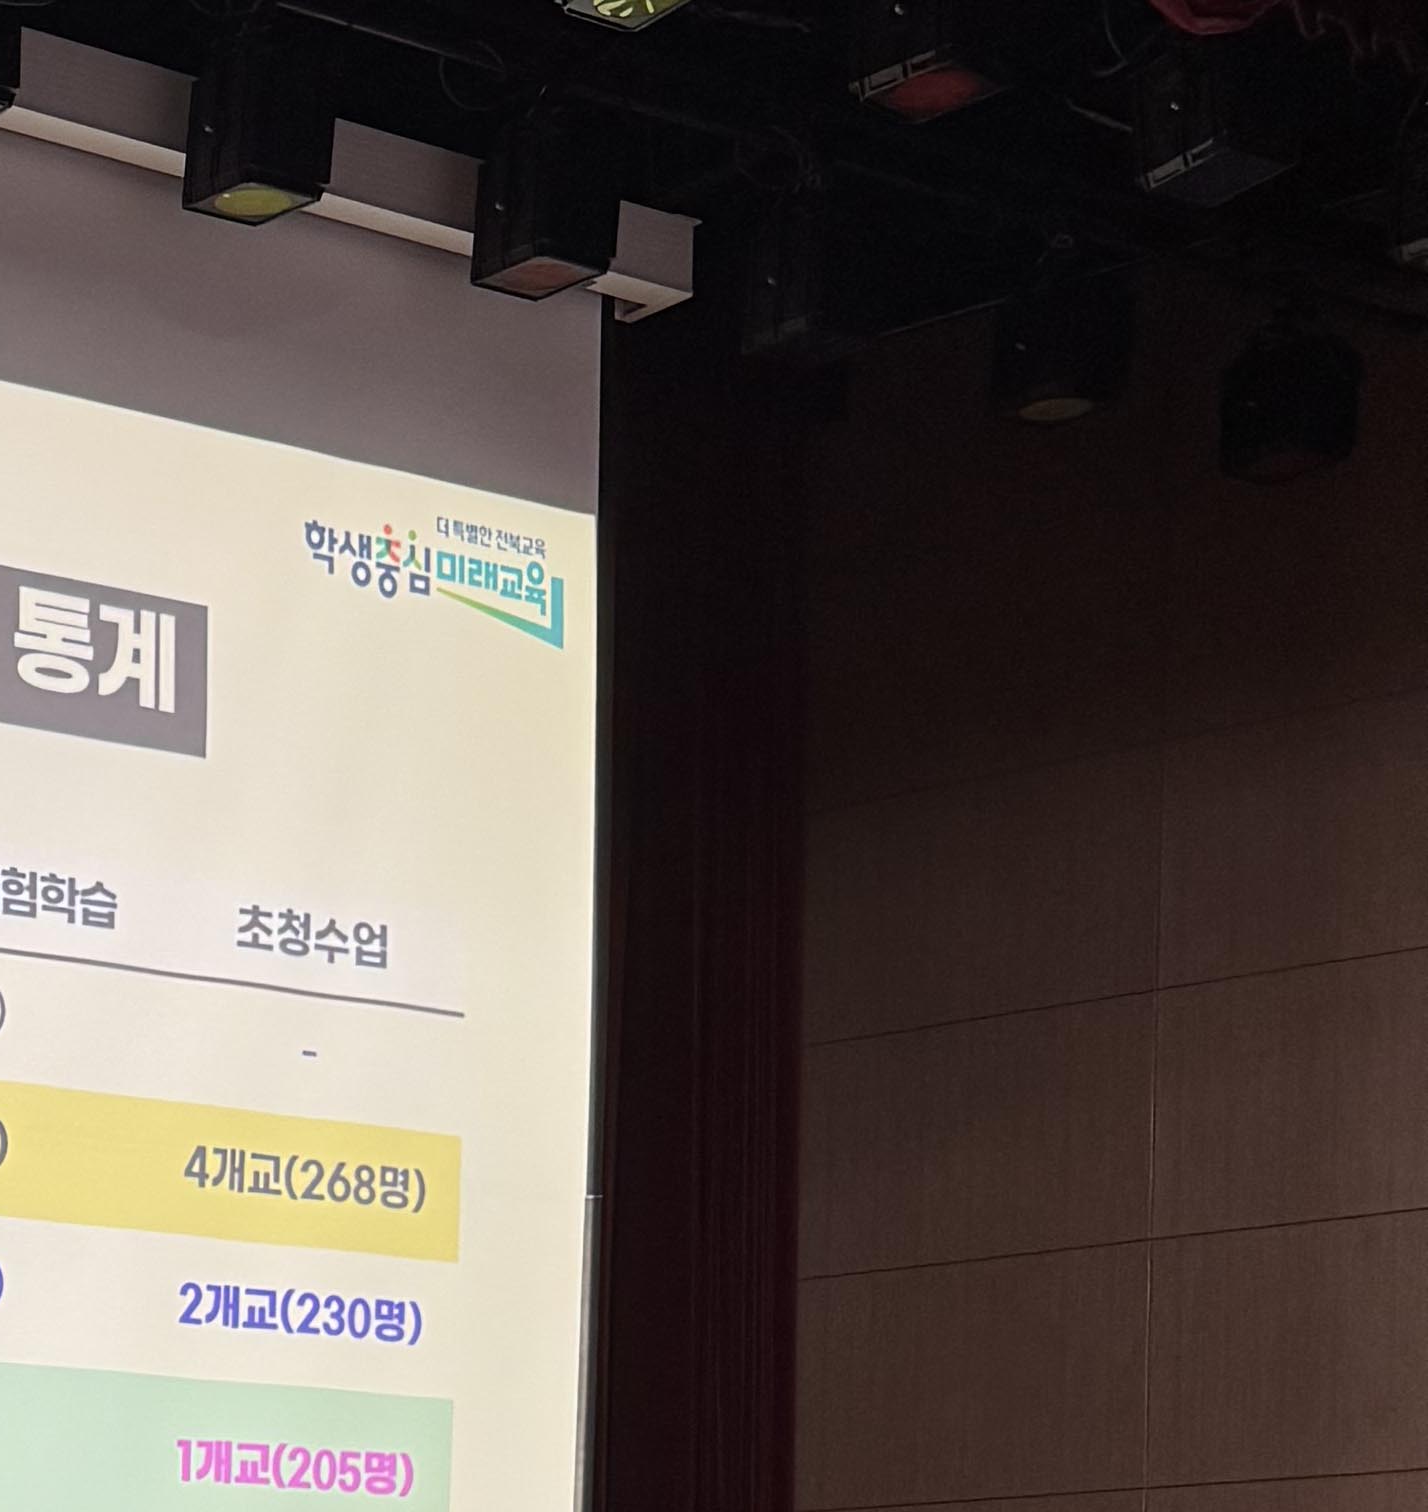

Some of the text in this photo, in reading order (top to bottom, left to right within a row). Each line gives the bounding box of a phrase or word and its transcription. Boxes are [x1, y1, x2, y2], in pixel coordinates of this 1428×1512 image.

[304, 519, 547, 617] 학생중심 미래교육
[436, 516, 547, 559] 더 특별한 전북교육
[11, 588, 177, 716] 통계
[235, 905, 390, 967] 초청수업
[183, 1144, 427, 1214] 4개교(268명)
[177, 1281, 424, 1346] 2개교(230명)
[175, 1438, 415, 1498] 1개교(205명)
